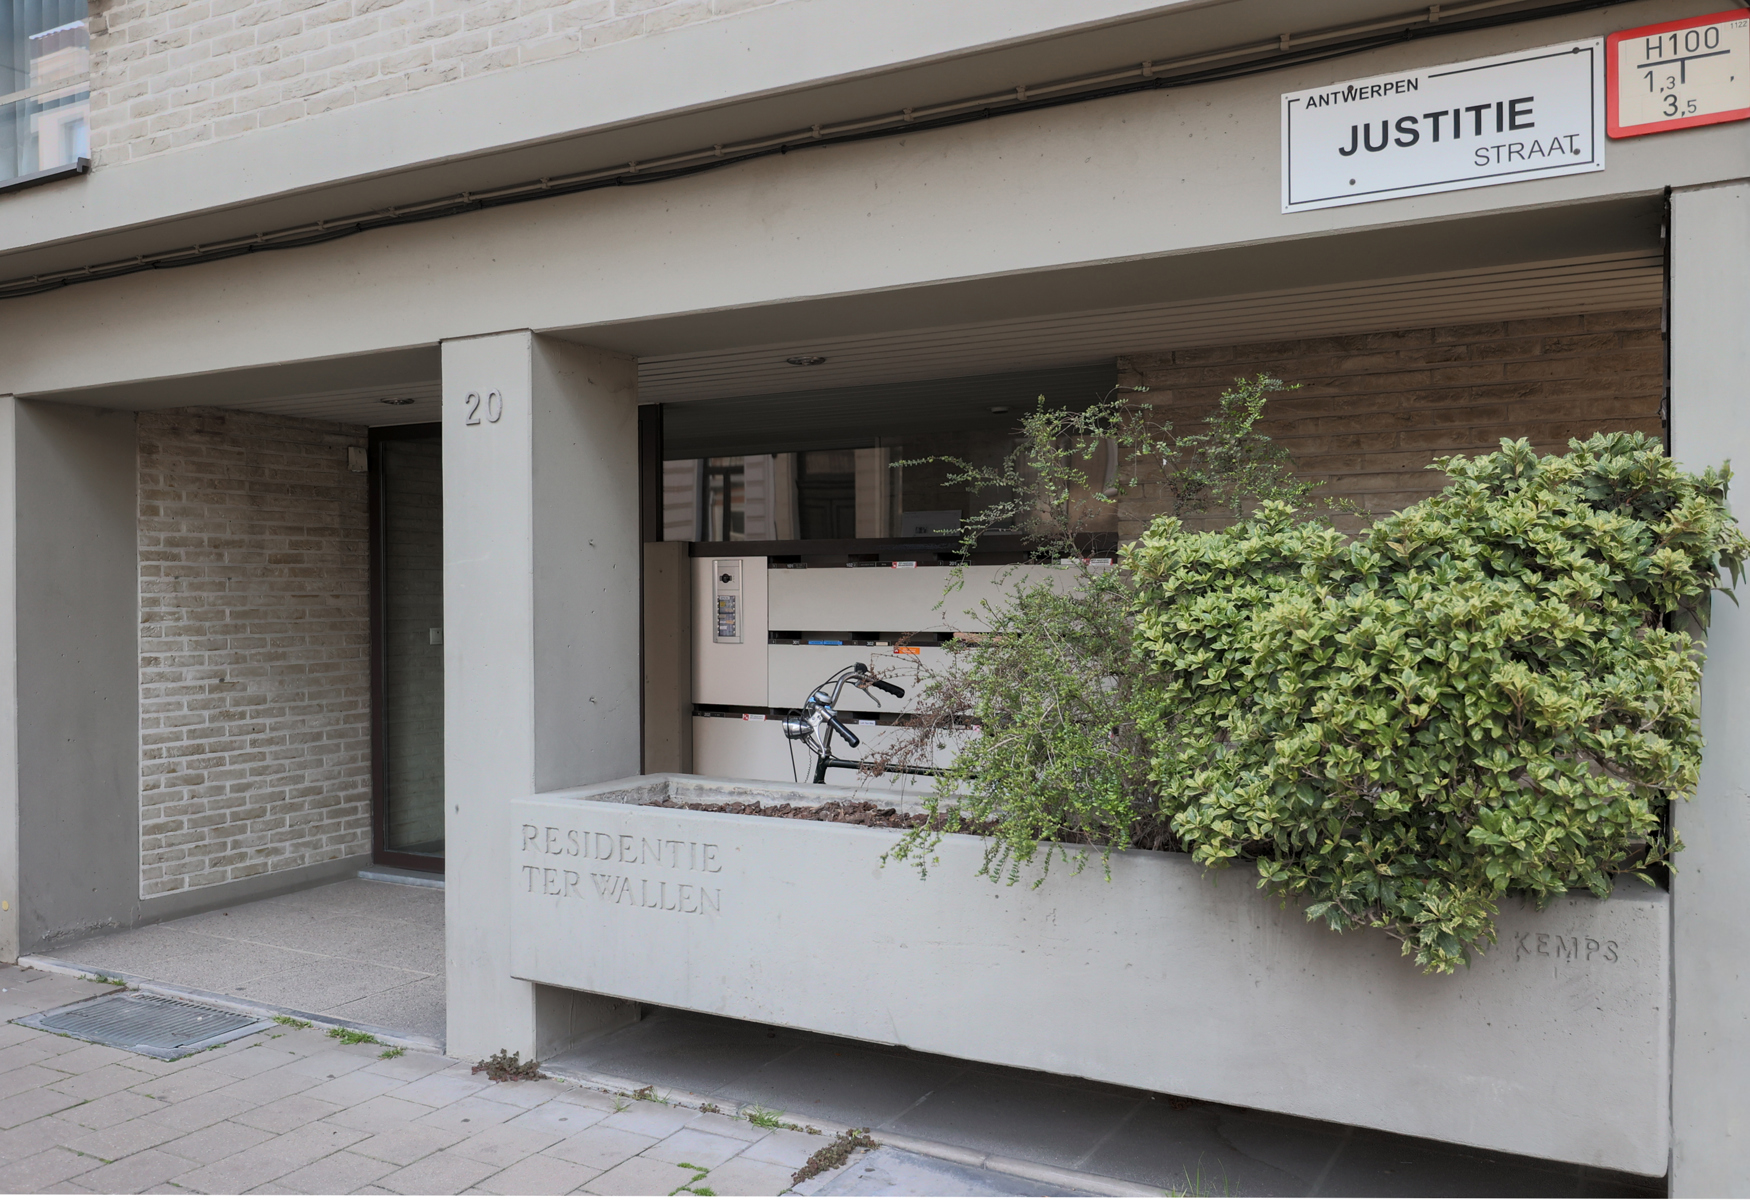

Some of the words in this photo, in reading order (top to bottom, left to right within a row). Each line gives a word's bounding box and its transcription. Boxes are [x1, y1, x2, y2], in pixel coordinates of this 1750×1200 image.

[1730, 20, 1748, 29] 1122
[1645, 26, 1719, 60] H100
[1305, 77, 1419, 110] ANTWERPEN
[1337, 96, 1536, 157] JUSTITIE
[1474, 133, 1581, 168] STRAAT
[464, 388, 503, 427] 20
[521, 823, 723, 874] RESIDENTIE
[521, 865, 584, 900] TER
[589, 872, 722, 917] WALLEN
[1514, 931, 1620, 964] KEMPS
